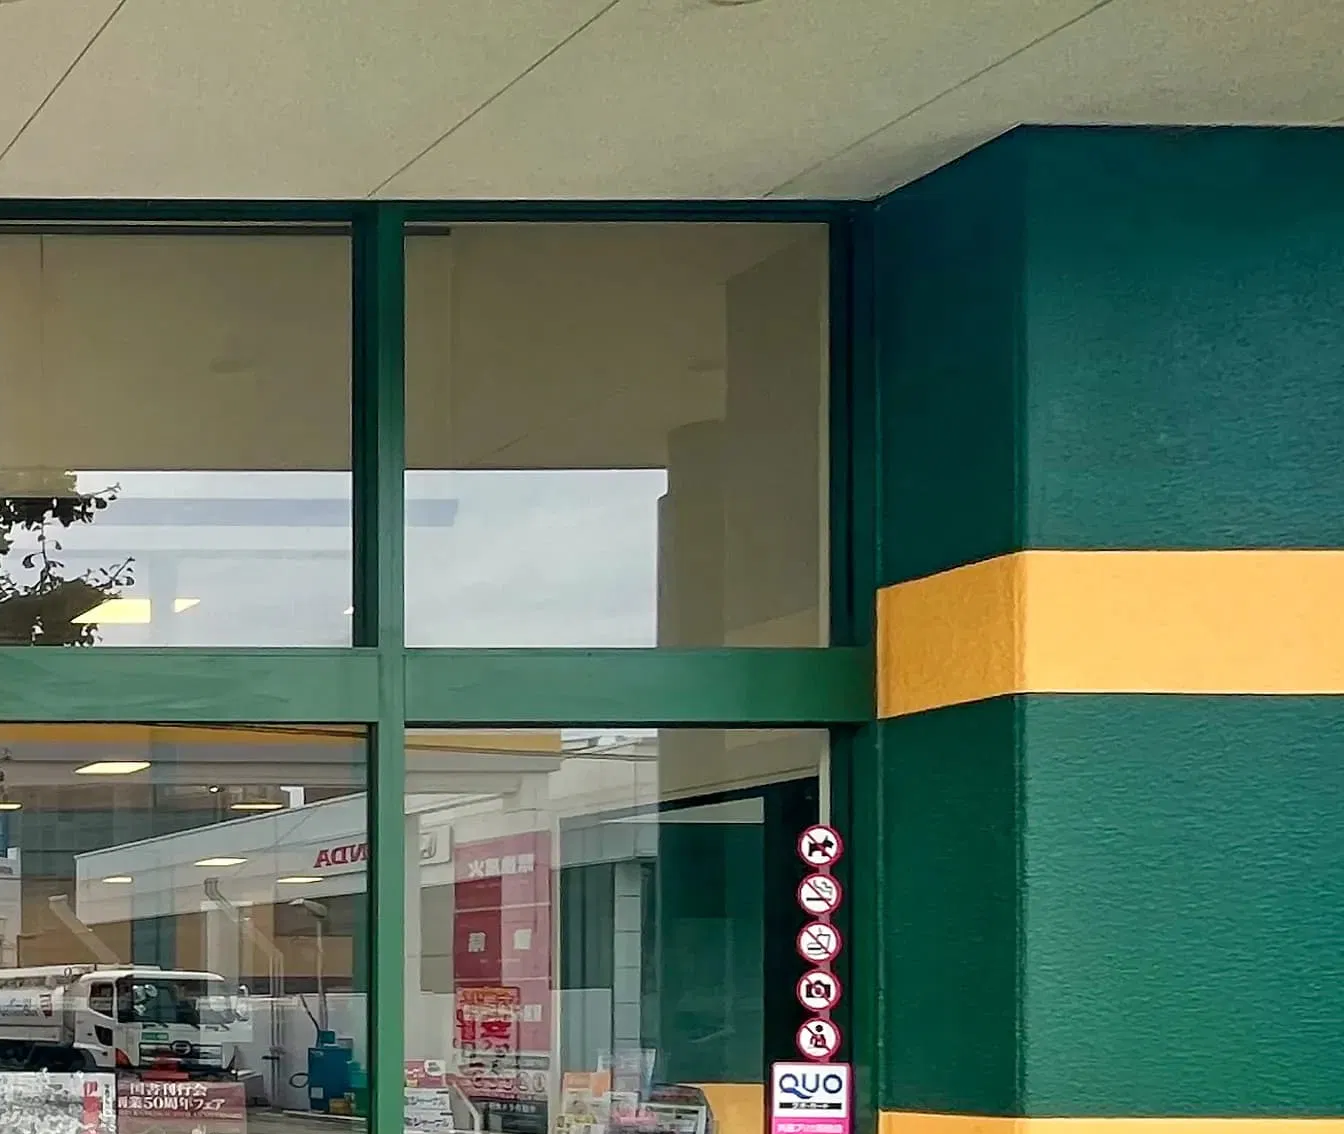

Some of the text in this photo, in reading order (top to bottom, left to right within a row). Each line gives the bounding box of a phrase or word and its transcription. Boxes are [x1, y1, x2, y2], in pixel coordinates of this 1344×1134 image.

[130, 1082, 209, 1097] 国書刊行会
[779, 1073, 843, 1099] QUO
